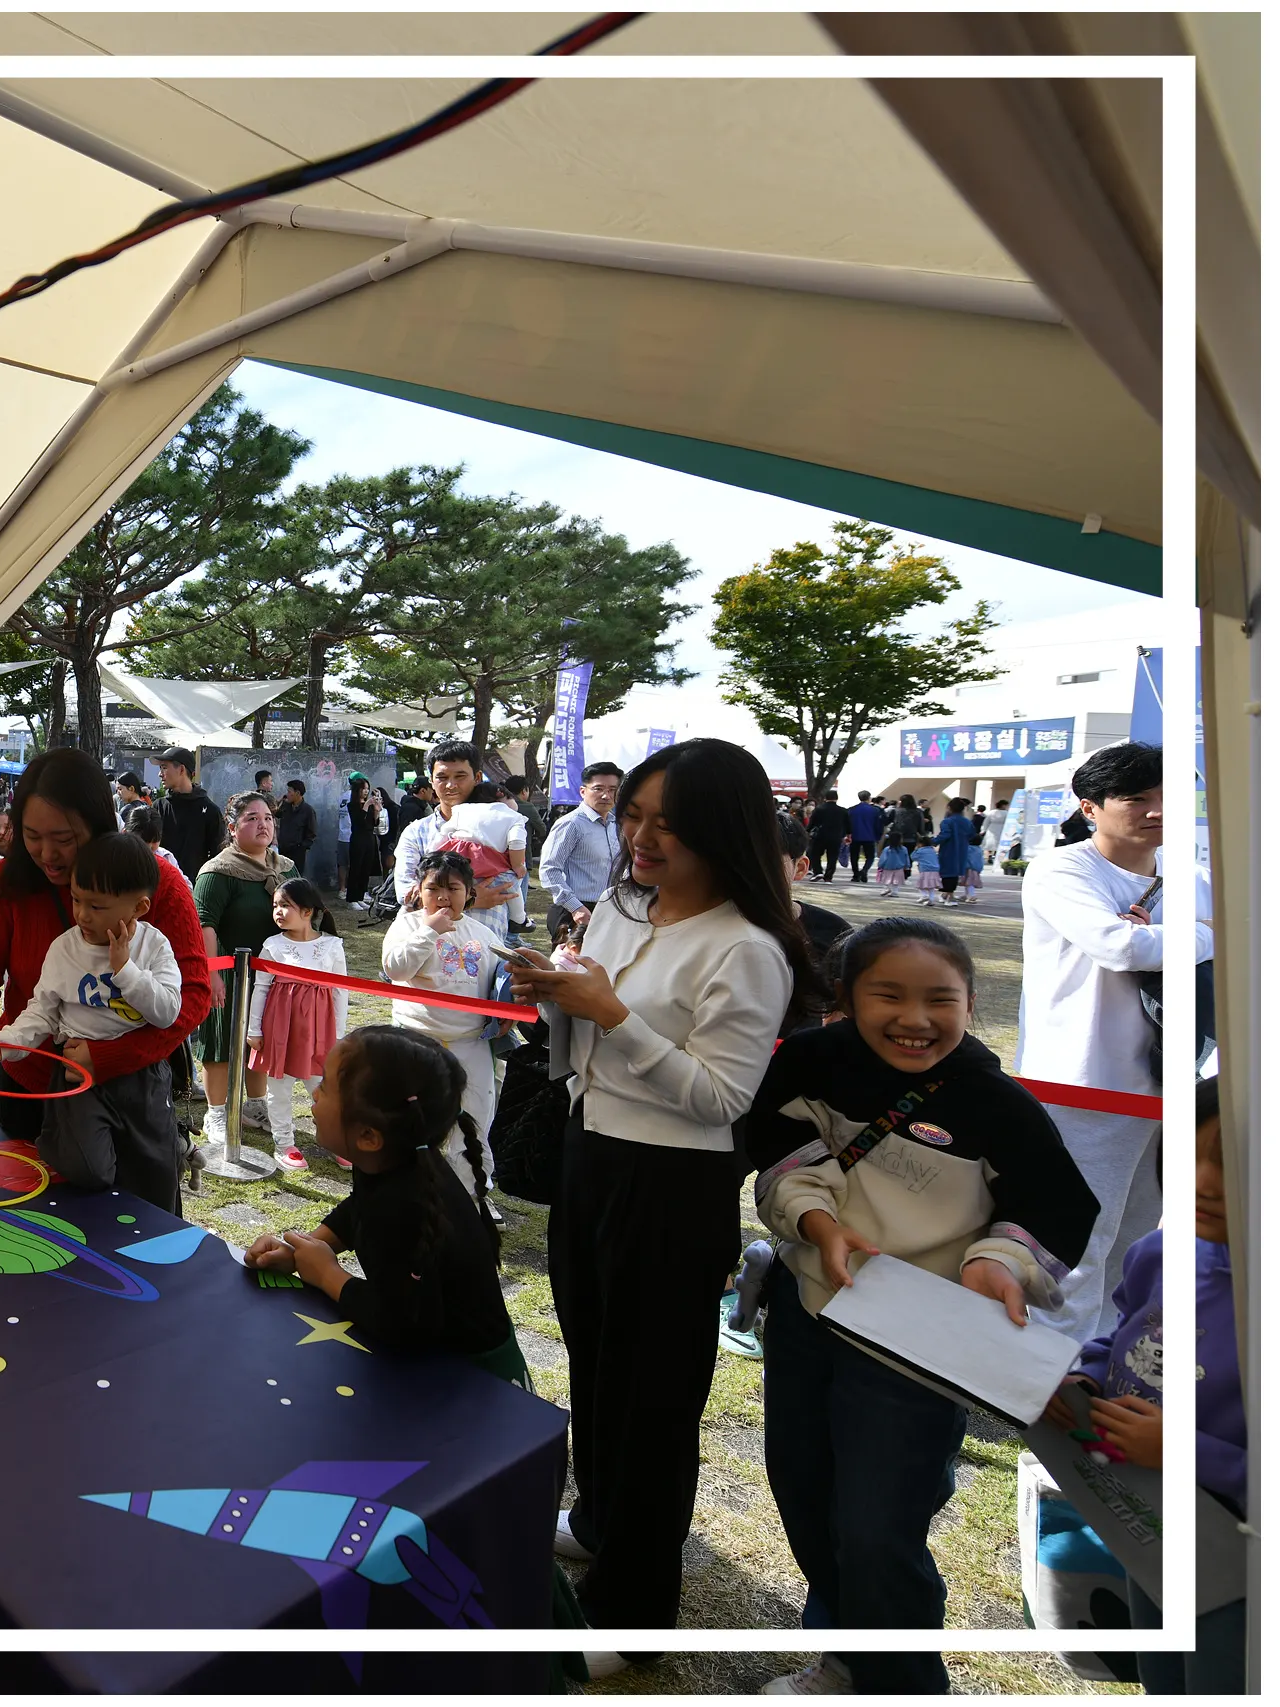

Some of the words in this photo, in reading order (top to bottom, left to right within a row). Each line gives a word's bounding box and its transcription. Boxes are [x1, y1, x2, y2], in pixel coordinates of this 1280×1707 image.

[570, 675, 581, 714] PICNIC
[567, 716, 577, 756] ROUNGE
[952, 728, 1015, 752] 화장실
[875, 1090, 924, 1132] LOVE
[913, 1124, 924, 1133] GO
[839, 1127, 881, 1167] LOVE
